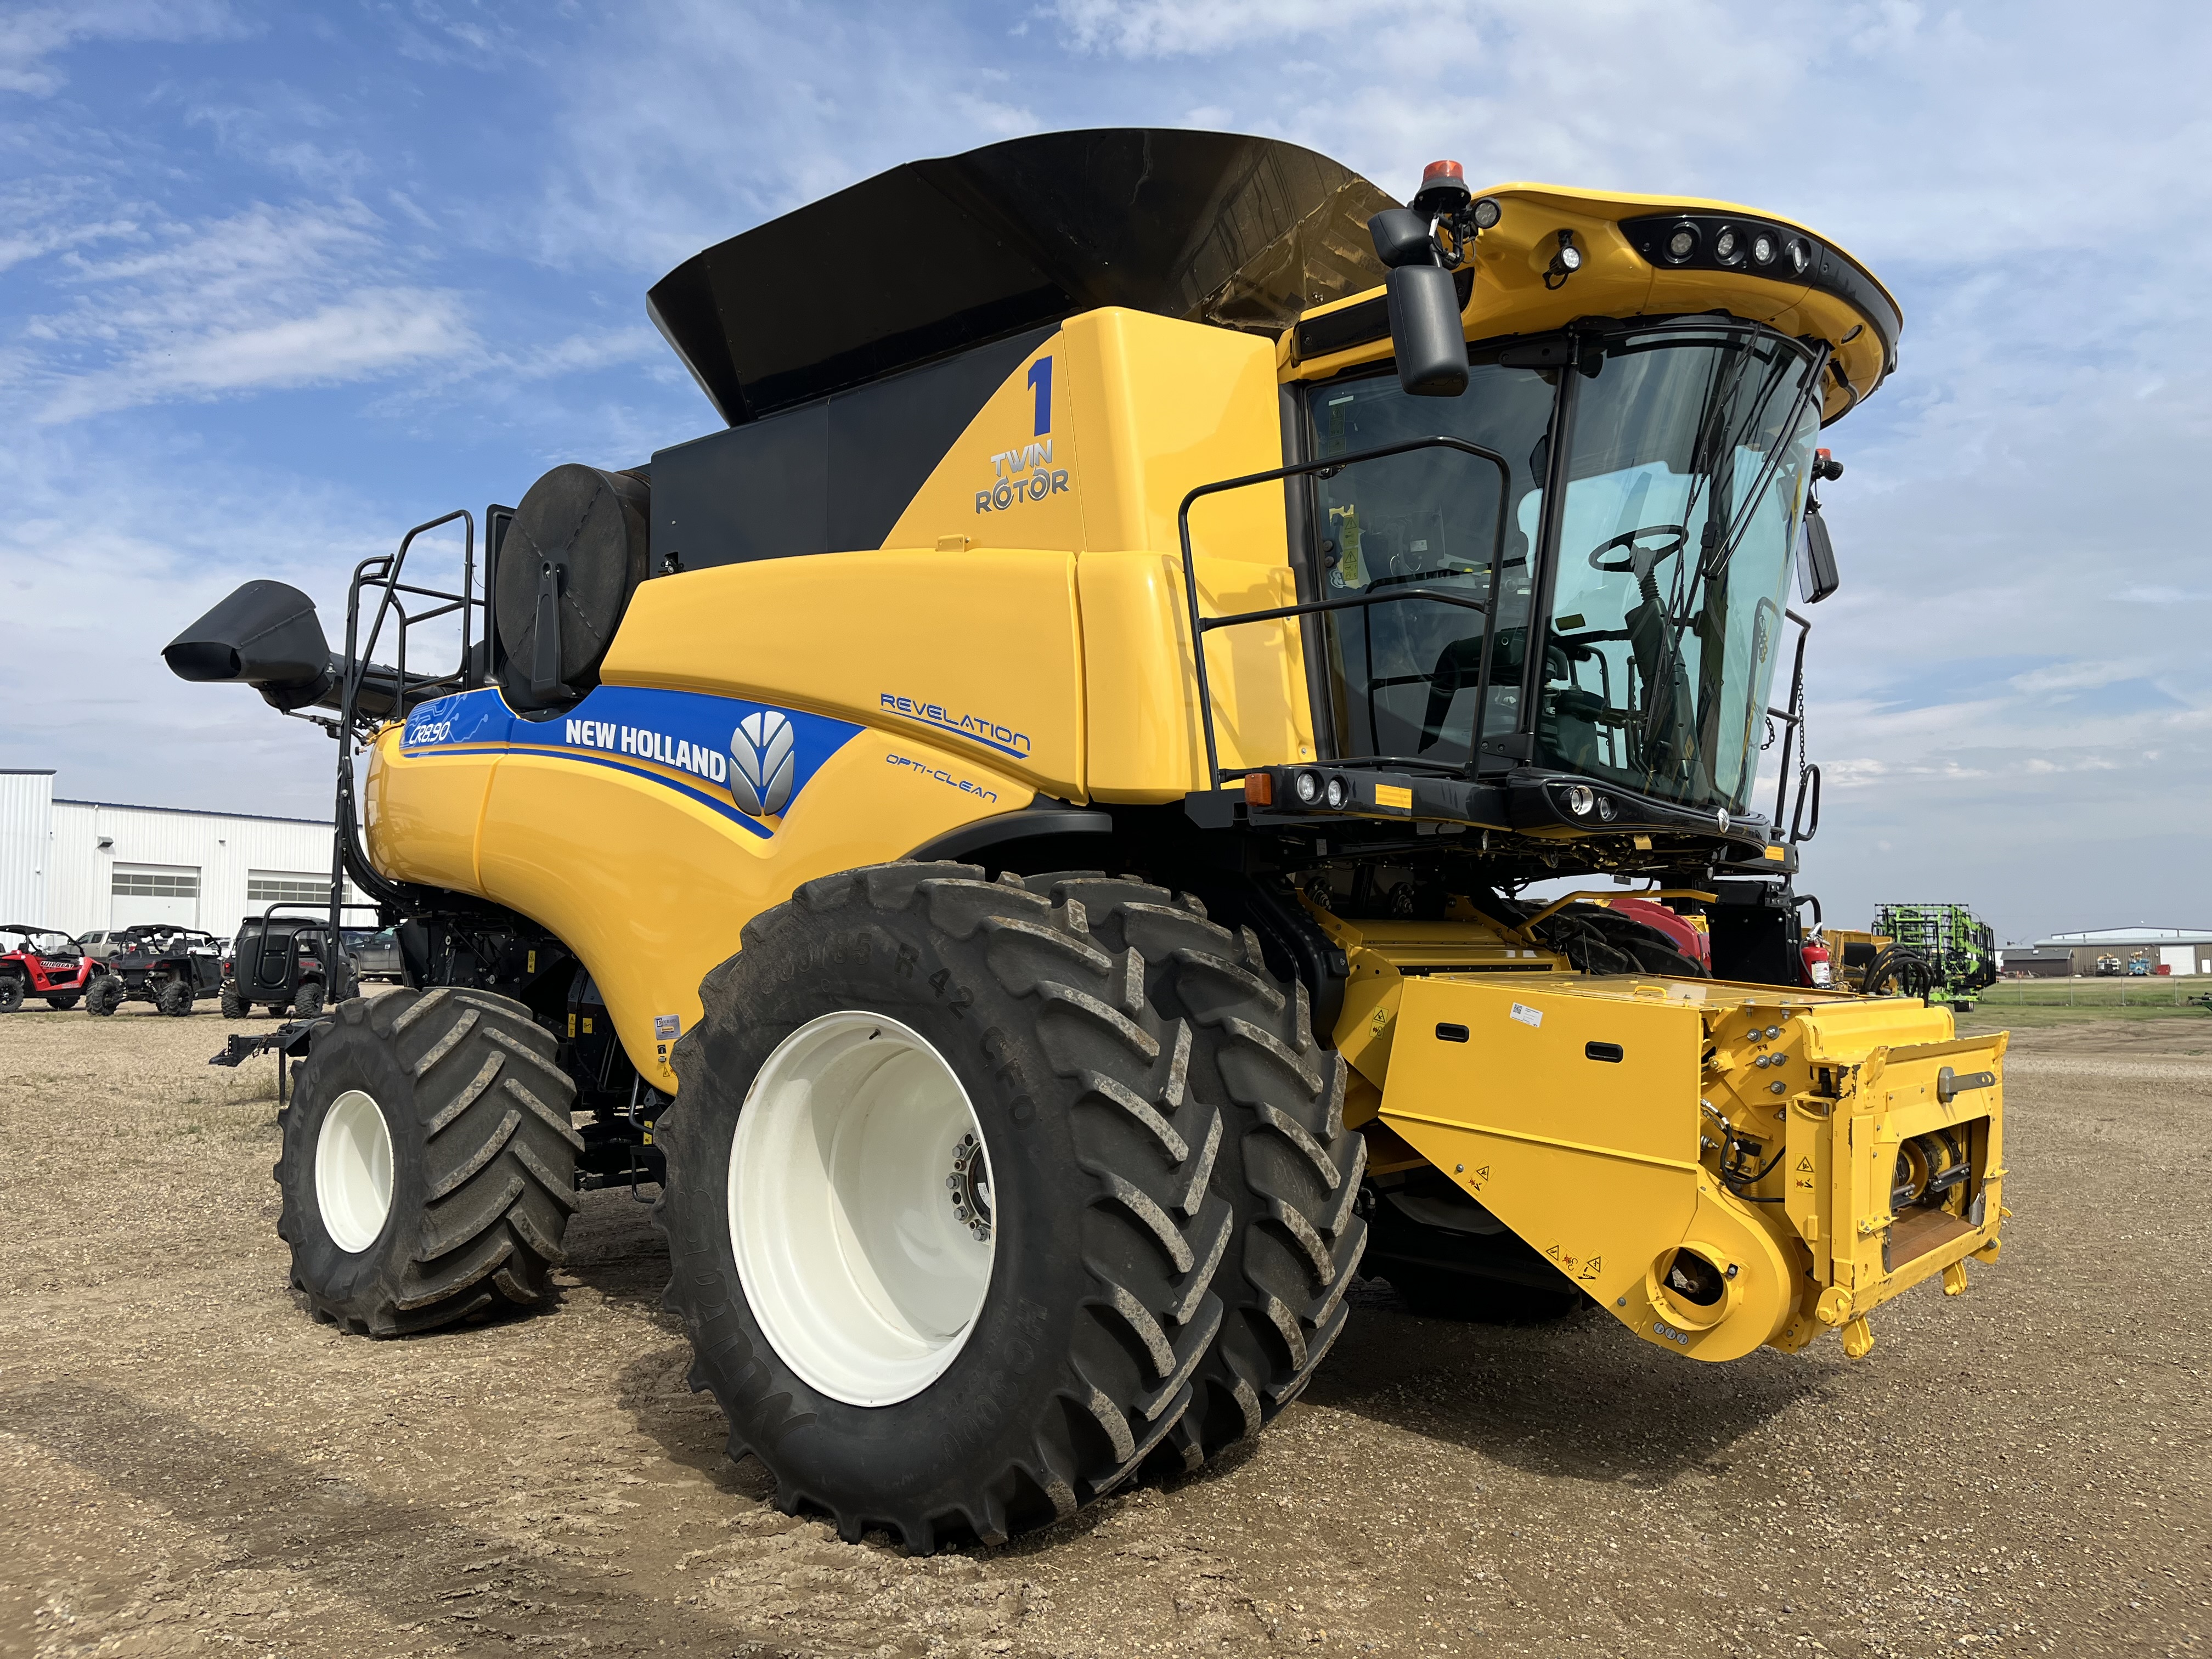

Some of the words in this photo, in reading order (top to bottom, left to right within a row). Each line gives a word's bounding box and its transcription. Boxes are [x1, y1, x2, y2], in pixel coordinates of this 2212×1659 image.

[1028, 355, 1053, 437] 1
[991, 439, 1052, 477] TWIN
[975, 467, 1070, 515] ROTOR
[409, 721, 450, 744] CR8.90
[881, 693, 1030, 752] REVELATION
[566, 719, 617, 750] NEW
[621, 725, 727, 783] HOLLAND
[886, 754, 997, 803] OPTI-CLEAN
[40, 961, 74, 969] WILDCAT
[927, 967, 975, 1022] 42
